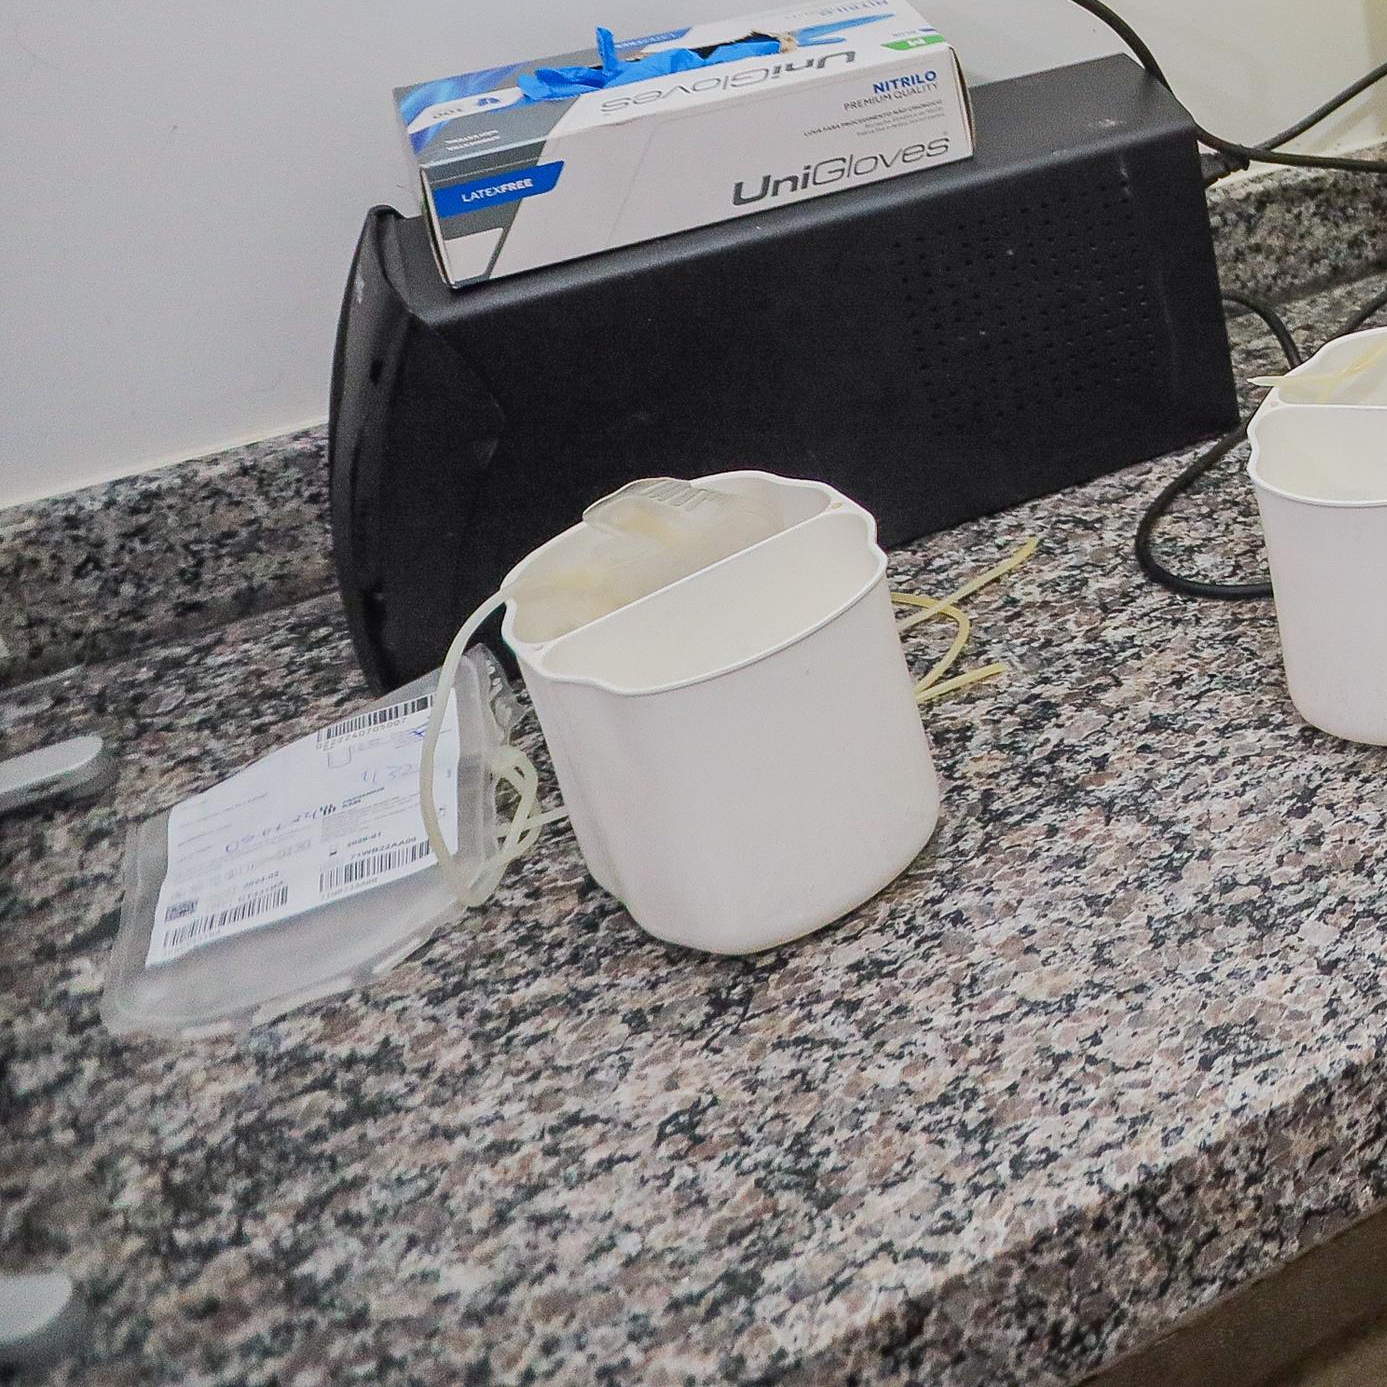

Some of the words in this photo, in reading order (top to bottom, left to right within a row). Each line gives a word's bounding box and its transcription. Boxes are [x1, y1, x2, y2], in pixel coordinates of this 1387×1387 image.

[600, 48, 857, 113] UniGloves
[873, 69, 937, 94] NITRILO
[842, 92, 894, 111] PREMIUM
[893, 82, 939, 101] QUALITY
[732, 132, 951, 207] UniGloves
[461, 178, 535, 203] LATEXFREE
